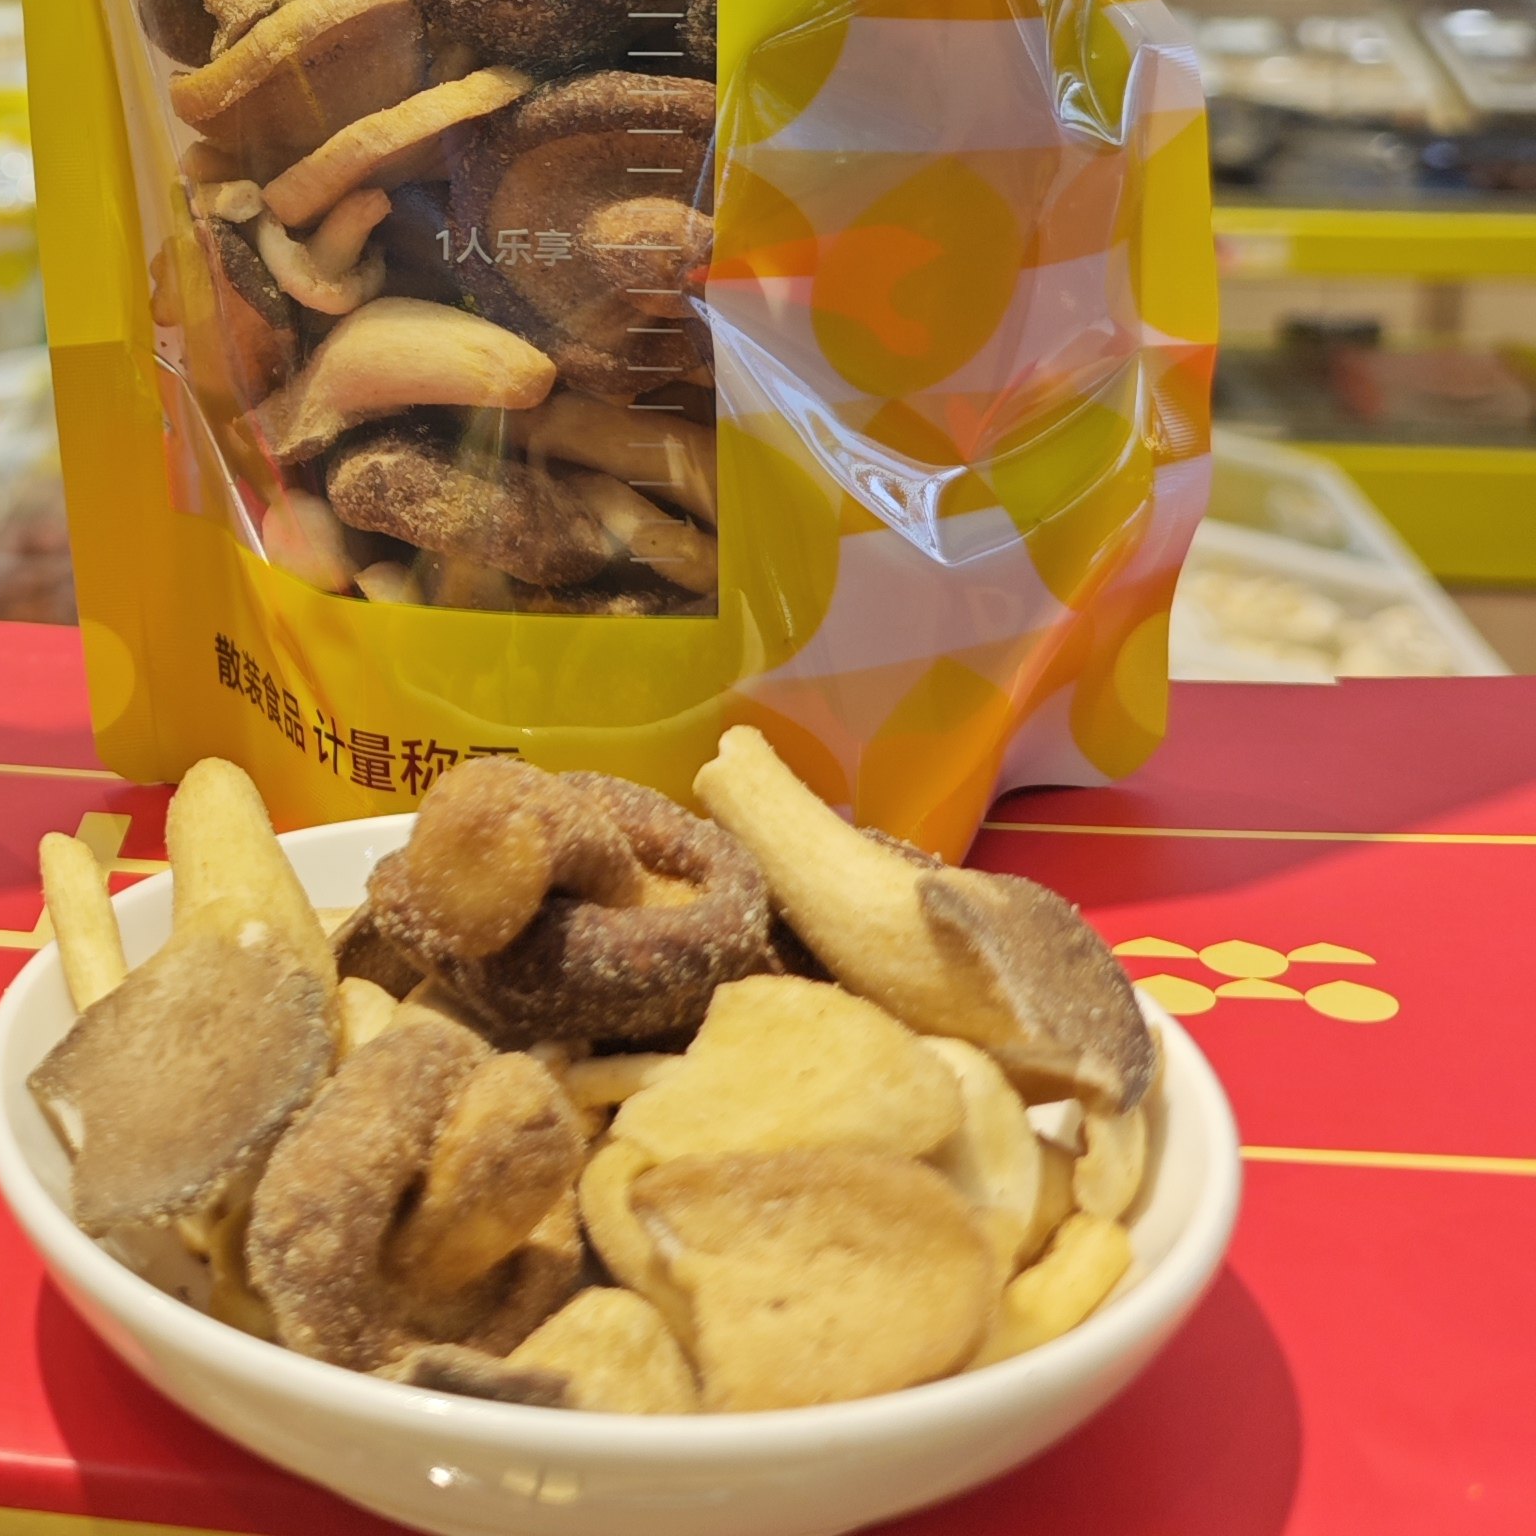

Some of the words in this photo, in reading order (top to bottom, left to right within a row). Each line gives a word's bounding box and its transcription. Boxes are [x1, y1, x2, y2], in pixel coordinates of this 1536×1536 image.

[435, 228, 573, 266] 1人乐享
[215, 632, 306, 753] 散装食品
[313, 708, 526, 795] 计量称
